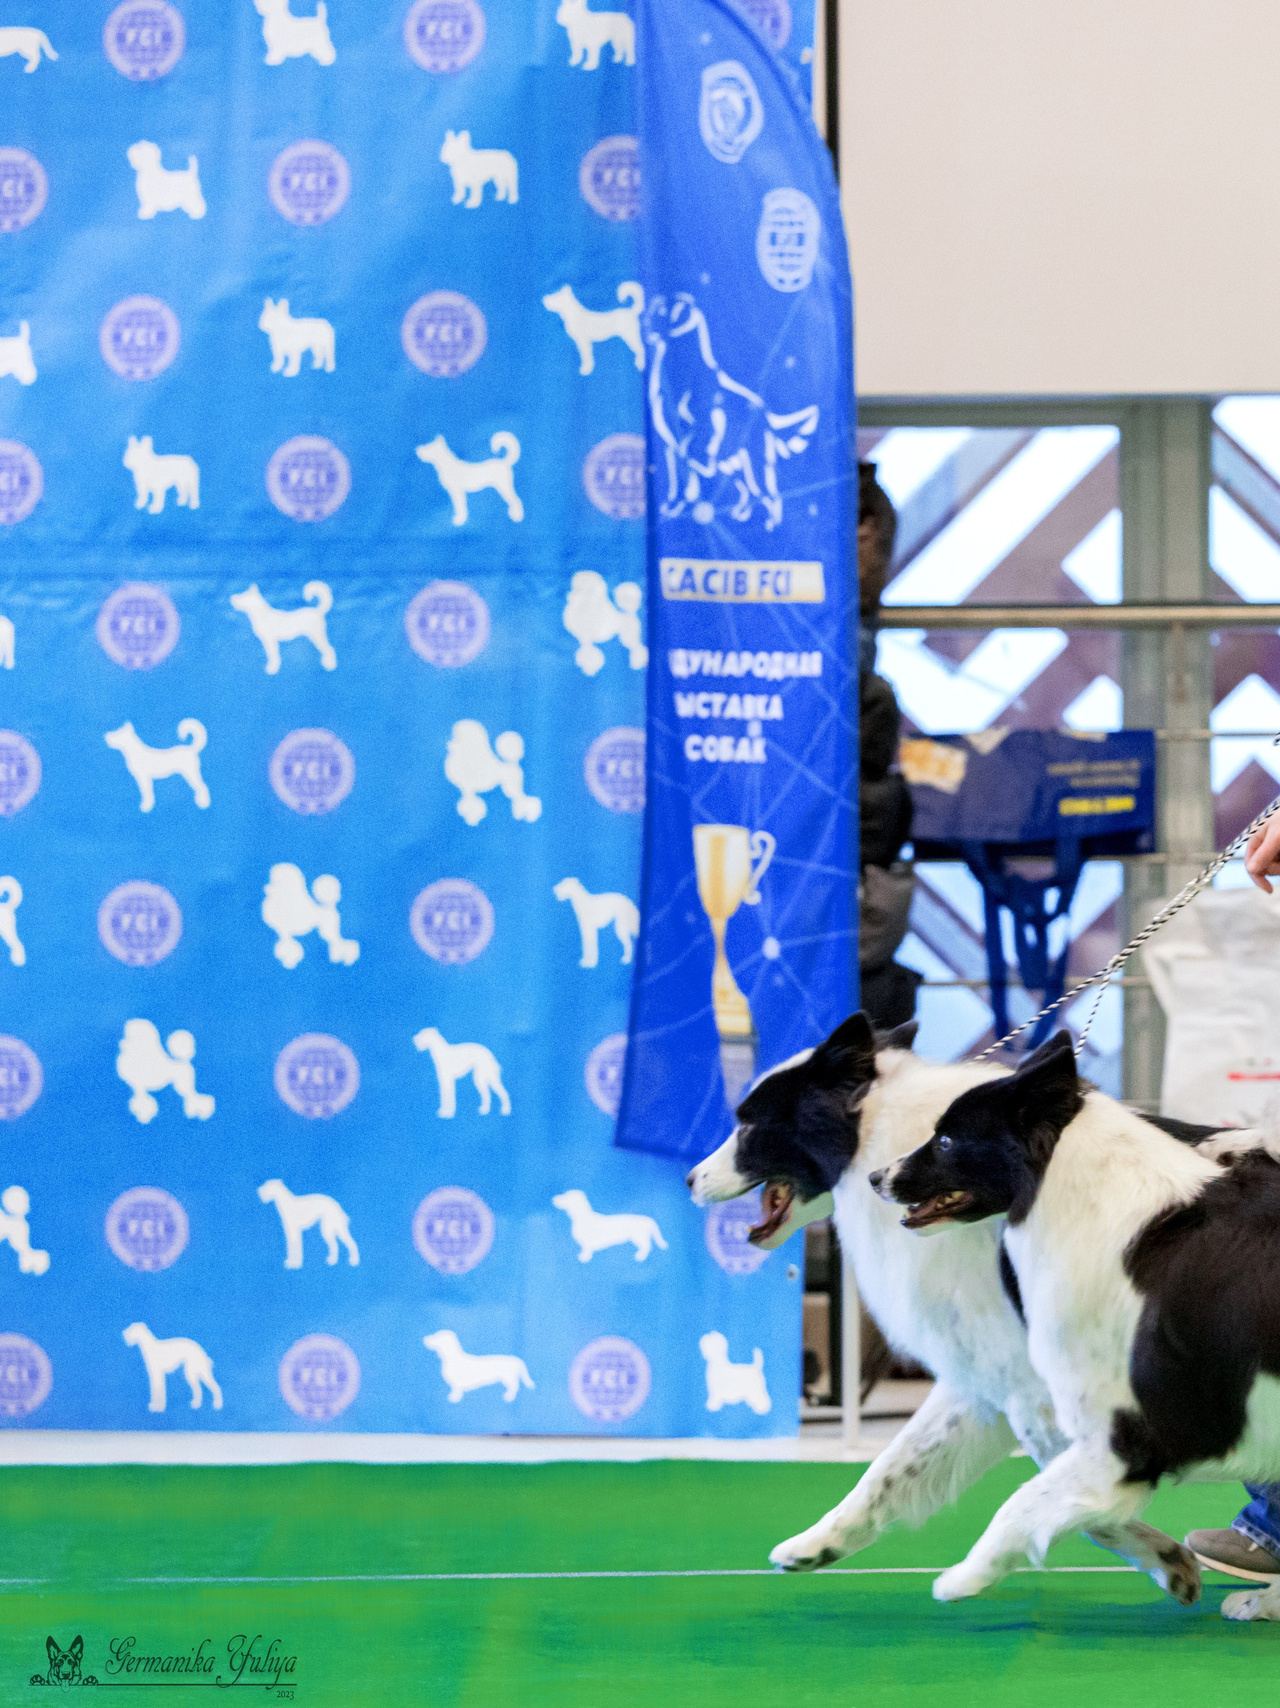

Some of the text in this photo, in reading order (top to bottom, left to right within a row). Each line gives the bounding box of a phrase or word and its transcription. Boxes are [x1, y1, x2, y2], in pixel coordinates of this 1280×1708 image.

[127, 28, 160, 46] FCI
[427, 20, 461, 38] FCI
[2, 180, 24, 197] CI
[291, 172, 326, 190] FCI
[122, 328, 156, 346] FCI
[426, 323, 460, 342] FCI
[0, 472, 18, 491] CI
[290, 468, 326, 486] FCI
[758, 569, 792, 597] FCI
[122, 616, 156, 634] FCI
[430, 613, 466, 632] FCI
[669, 648, 823, 682] ДУНАРОДНАЯ
[674, 691, 784, 721] ЫСТАВКА
[684, 734, 767, 764] СОБАК
[293, 761, 328, 780] FCI
[121, 913, 157, 933] FCI
[434, 910, 470, 931] FCI
[0, 1067, 18, 1087] CI
[299, 1065, 335, 1085] FCI
[130, 1219, 165, 1239] FCI
[436, 1219, 471, 1239] FCI
[7, 1365, 28, 1384] CI
[302, 1367, 337, 1387] FCI
[591, 1369, 627, 1389] FCI
